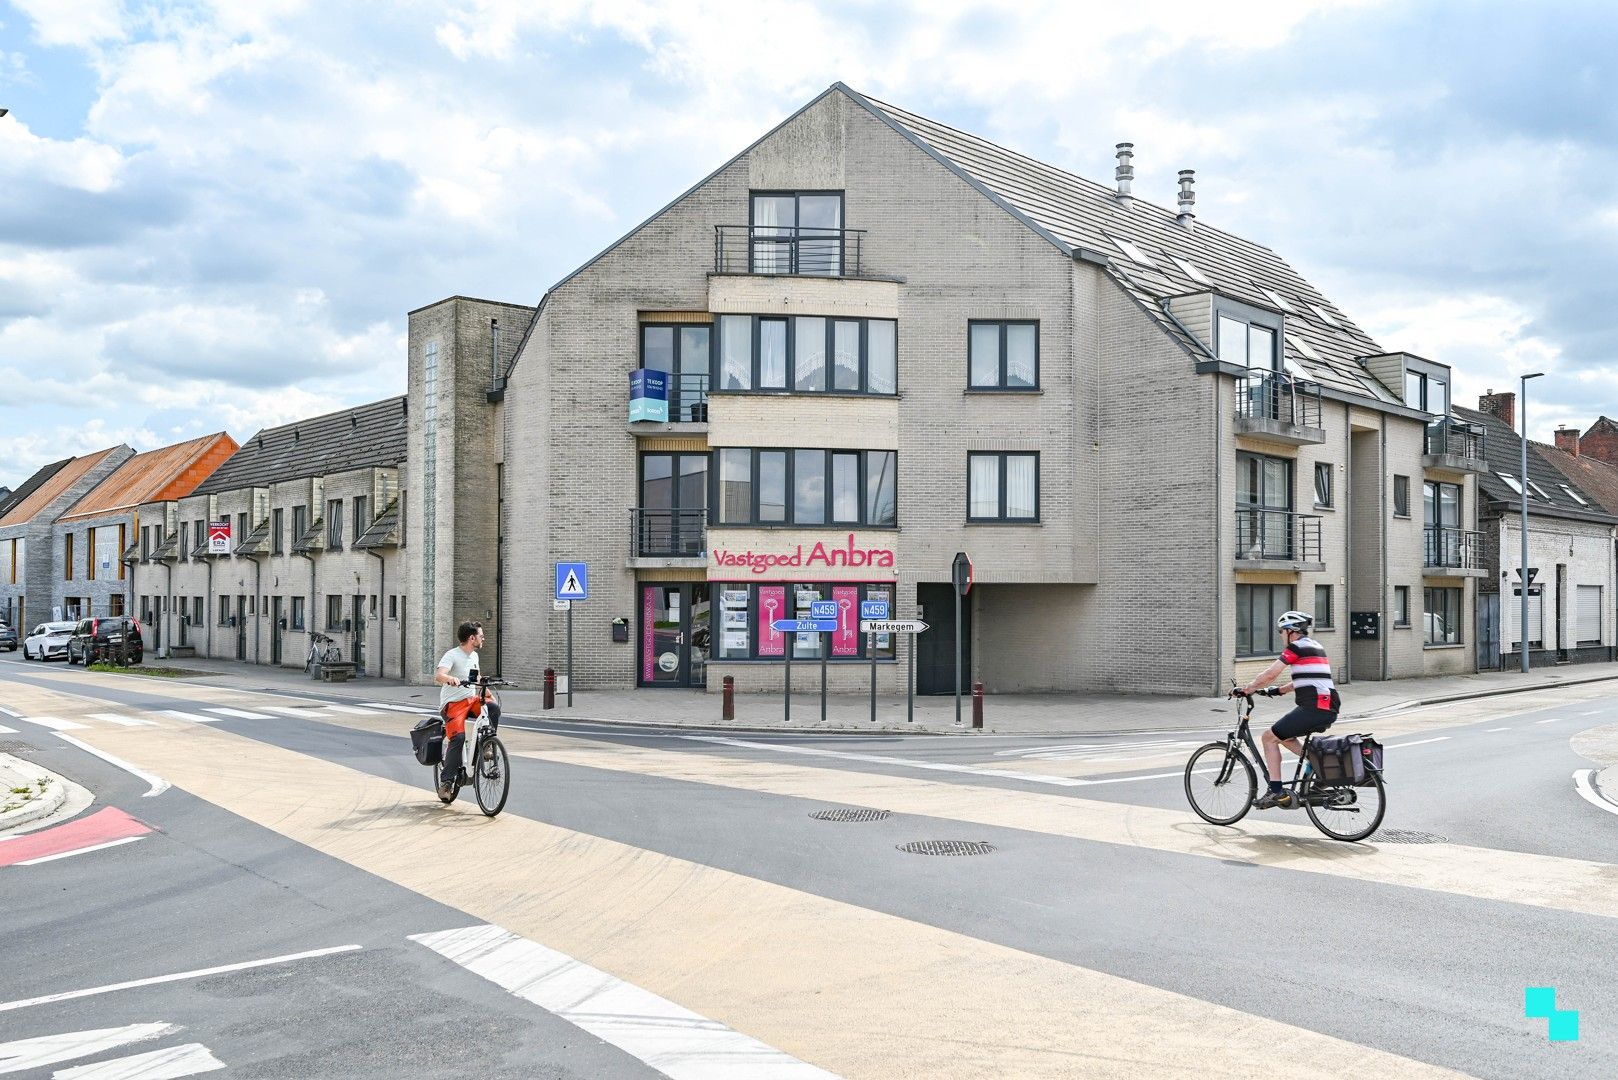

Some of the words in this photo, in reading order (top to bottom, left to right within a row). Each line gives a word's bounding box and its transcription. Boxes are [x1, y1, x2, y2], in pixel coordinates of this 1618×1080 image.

[713, 544, 801, 574] Vastgoed
[805, 533, 895, 567] Anbra
[759, 588, 784, 596] Vastgoed
[832, 588, 857, 596] Vastgoed
[814, 605, 835, 615] N459
[864, 605, 885, 615] N459
[796, 621, 818, 630] Zulte
[869, 622, 914, 633] Markegem
[759, 643, 784, 653] Anbra
[832, 643, 857, 653] Anbra
